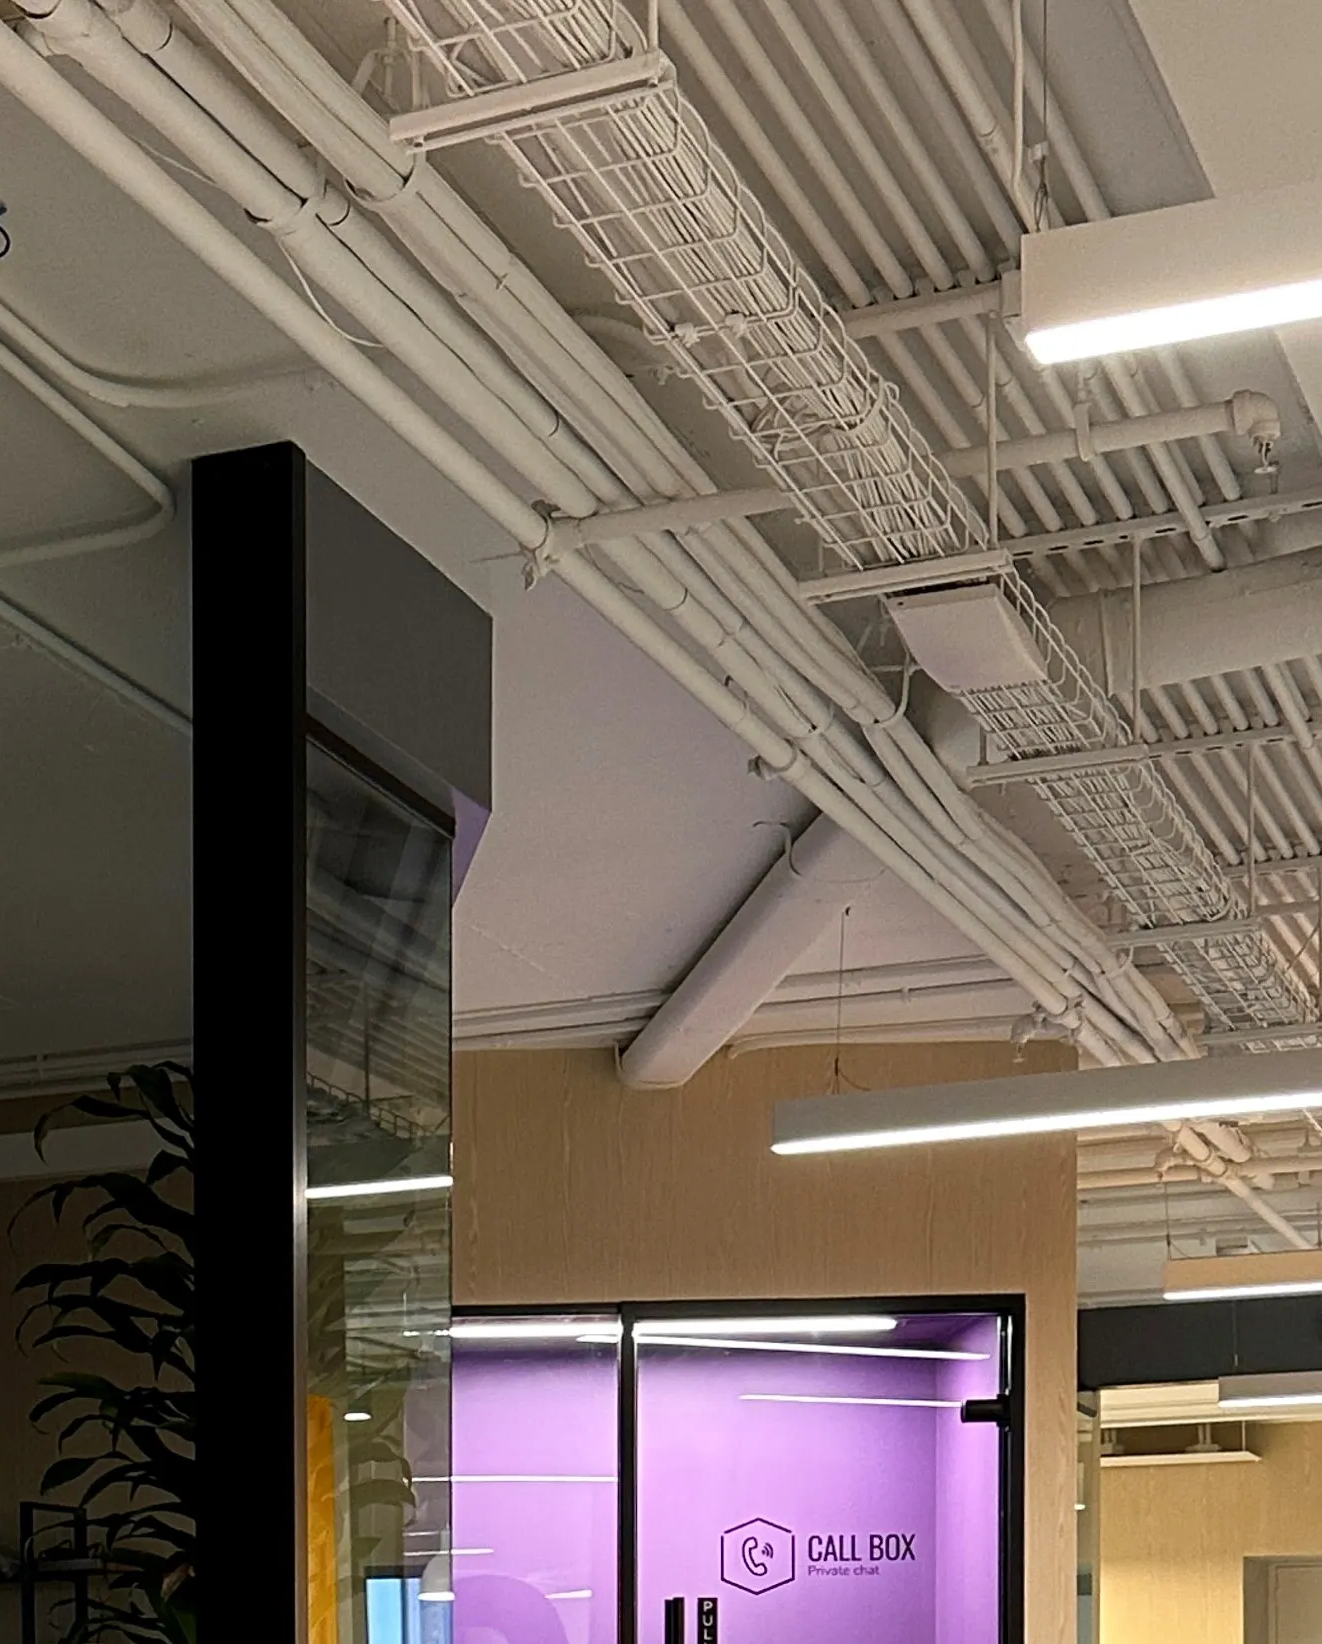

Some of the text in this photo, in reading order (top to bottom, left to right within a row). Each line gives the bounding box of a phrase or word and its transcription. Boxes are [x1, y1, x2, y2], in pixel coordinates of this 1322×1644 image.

[807, 1533, 916, 1562] CALL BOX
[807, 1564, 880, 1576] Private chat
